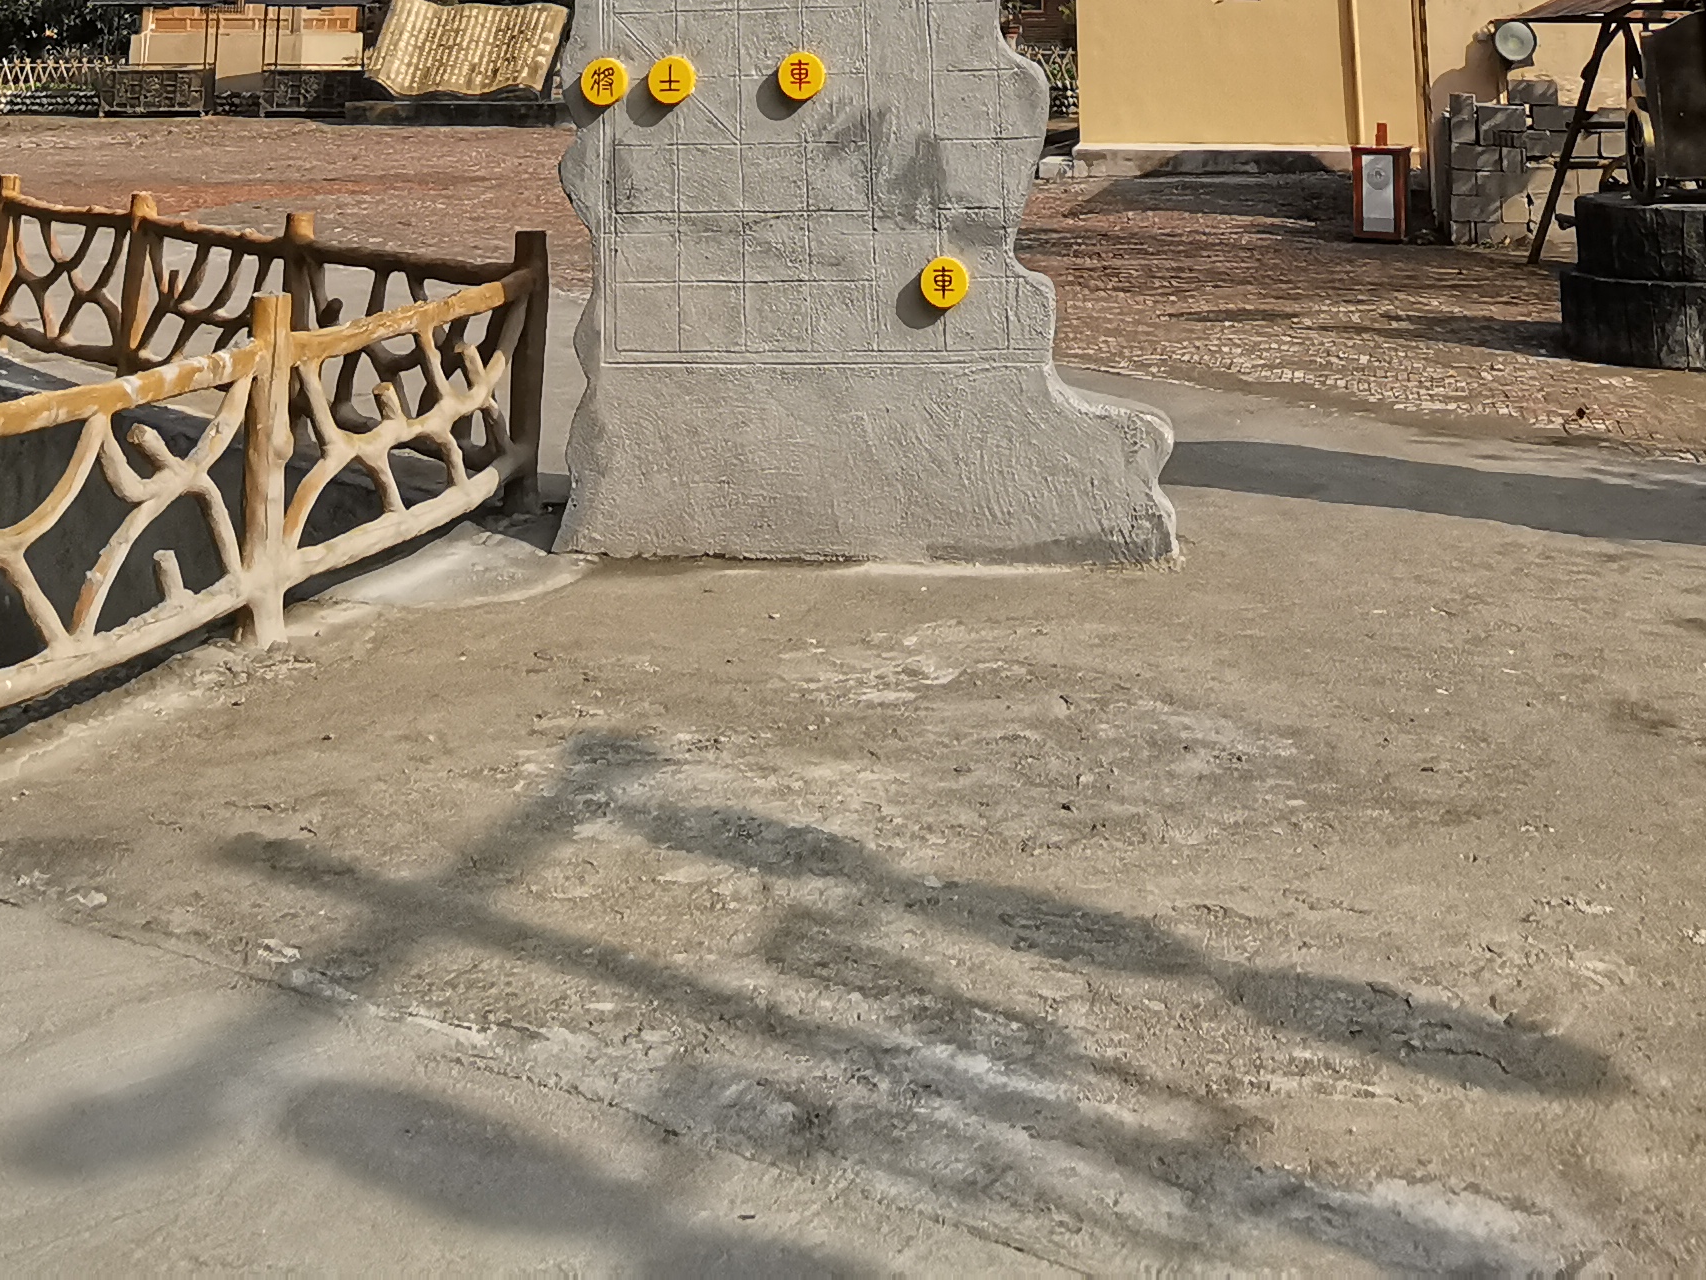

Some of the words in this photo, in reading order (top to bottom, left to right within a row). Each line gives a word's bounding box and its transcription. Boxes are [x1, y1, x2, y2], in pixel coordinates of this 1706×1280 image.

[658, 63, 681, 92] 士
[789, 58, 812, 92] 車
[932, 265, 955, 300] 車
